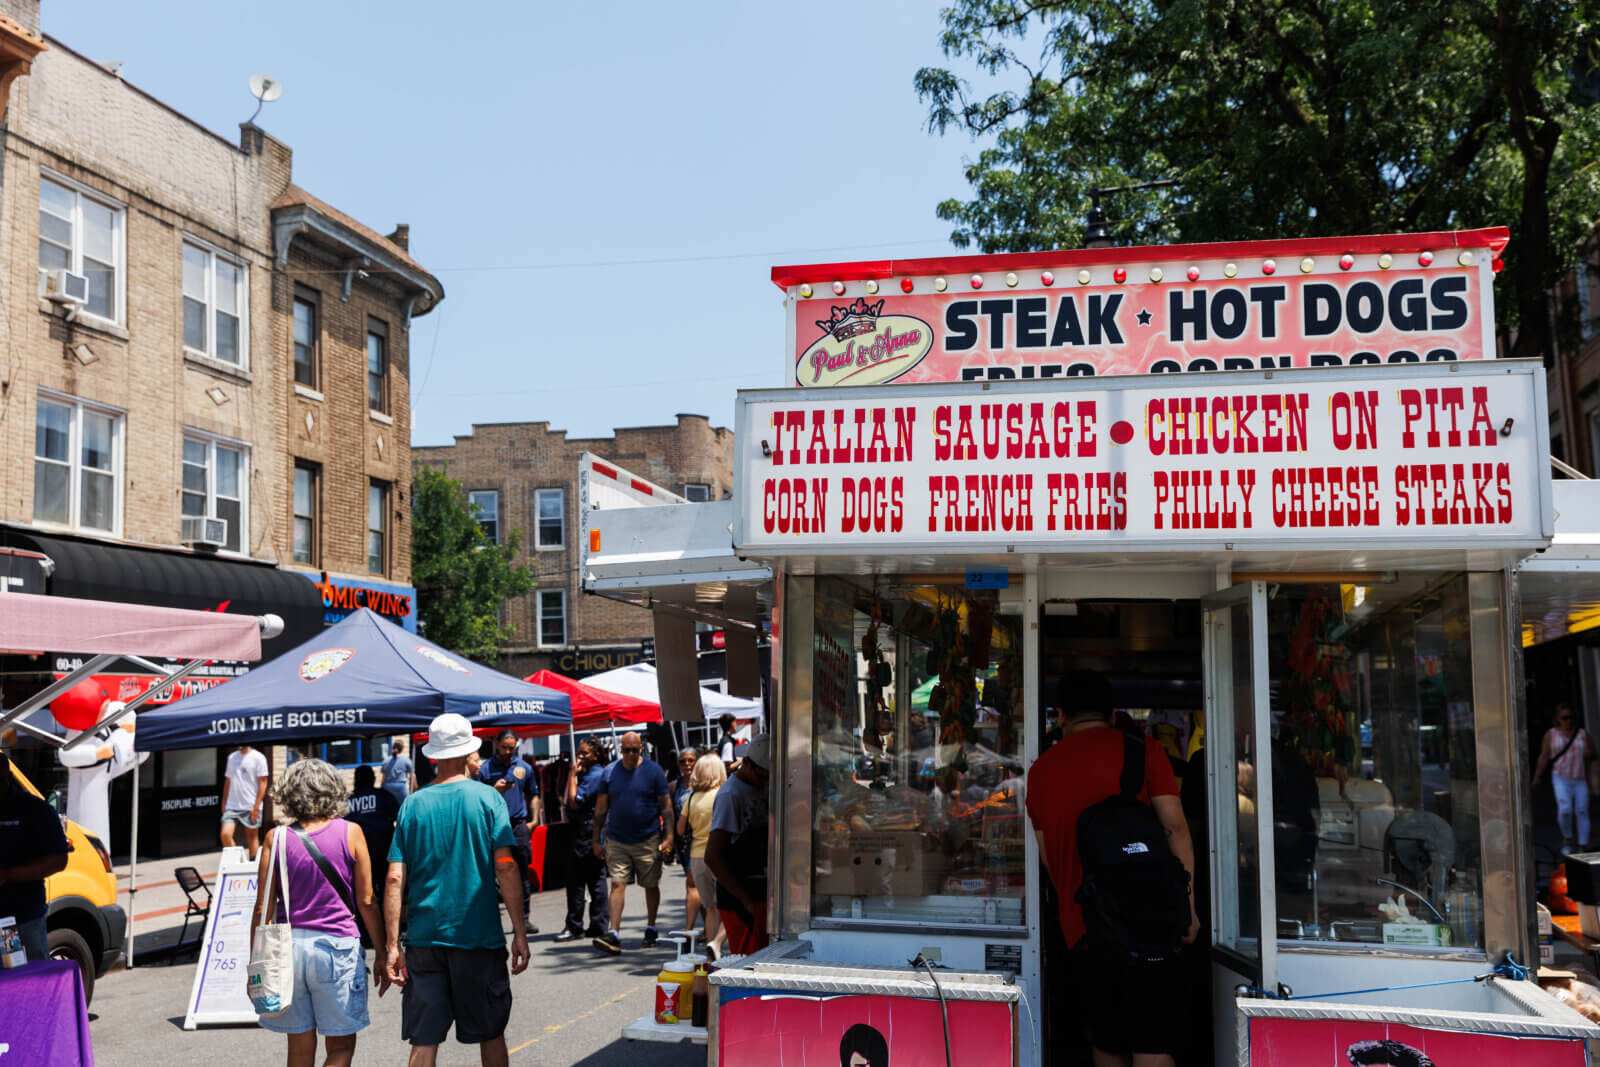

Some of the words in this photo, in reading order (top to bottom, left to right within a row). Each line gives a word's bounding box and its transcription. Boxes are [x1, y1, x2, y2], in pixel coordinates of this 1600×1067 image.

[946, 294, 1124, 351] STEAK
[1169, 286, 1286, 342] HOT
[1303, 276, 1468, 336] DOGS
[810, 341, 854, 383] Paul
[856, 345, 871, 367] &
[869, 326, 921, 362] Anna
[772, 407, 916, 465] ITALIAN
[935, 401, 1097, 461] SAUSAGE
[1148, 393, 1309, 456] CHICKEN
[1332, 391, 1379, 450] ON
[1400, 387, 1497, 448] PITA
[764, 478, 828, 533] CORN
[841, 476, 903, 533] DOGS
[928, 474, 1033, 532] FRENCH
[1047, 472, 1127, 531] FRIES
[1153, 469, 1256, 529] PHILLY
[1272, 466, 1380, 528] CHEESE
[1395, 463, 1512, 526] STEAKS
[366, 589, 411, 617] WINGS
[208, 717, 246, 734] JOIN
[250, 714, 283, 731] THE
[287, 708, 367, 728] BOLDEST
[480, 702, 496, 716] JOIN
[497, 701, 512, 714] THE
